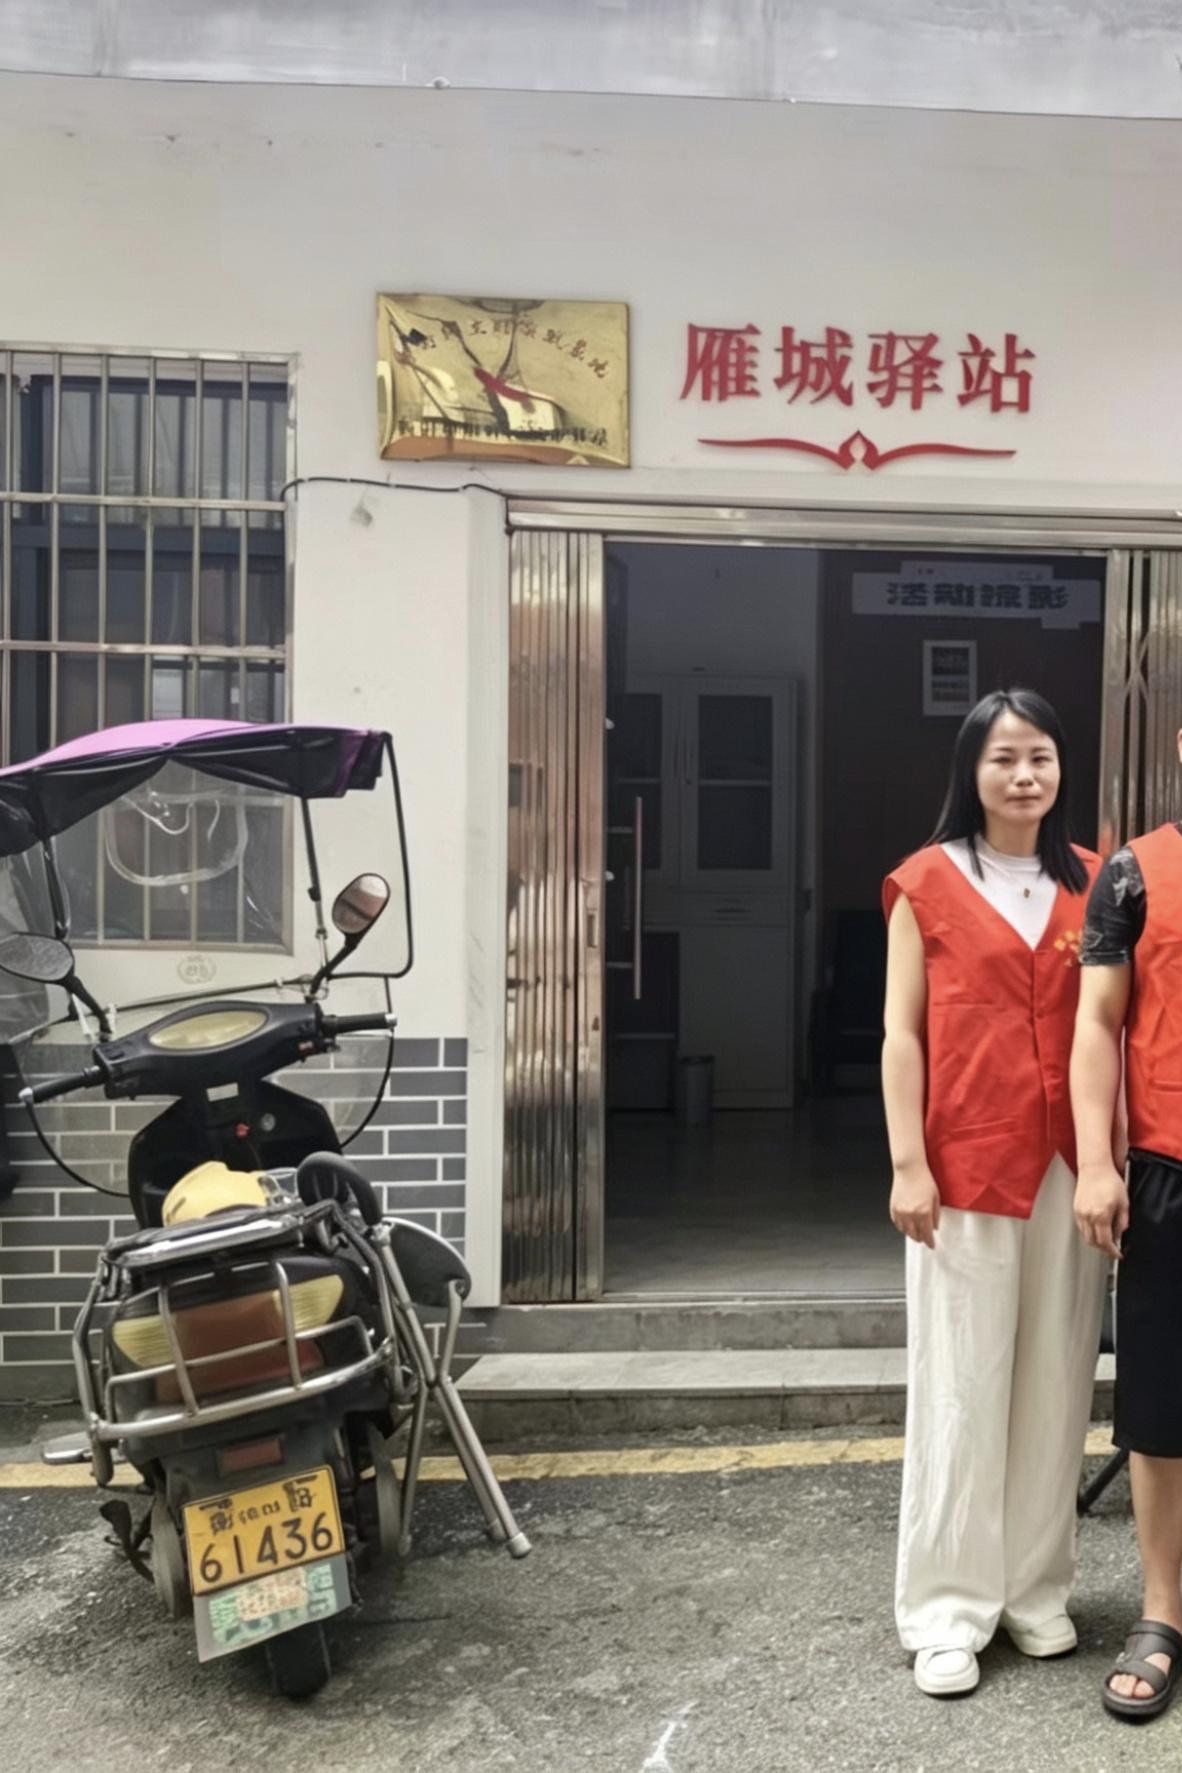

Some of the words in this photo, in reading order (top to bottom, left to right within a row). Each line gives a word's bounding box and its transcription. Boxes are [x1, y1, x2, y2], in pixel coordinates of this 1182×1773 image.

[679, 322, 1036, 413] 雁城驿站
[199, 1511, 334, 1584] 61436
